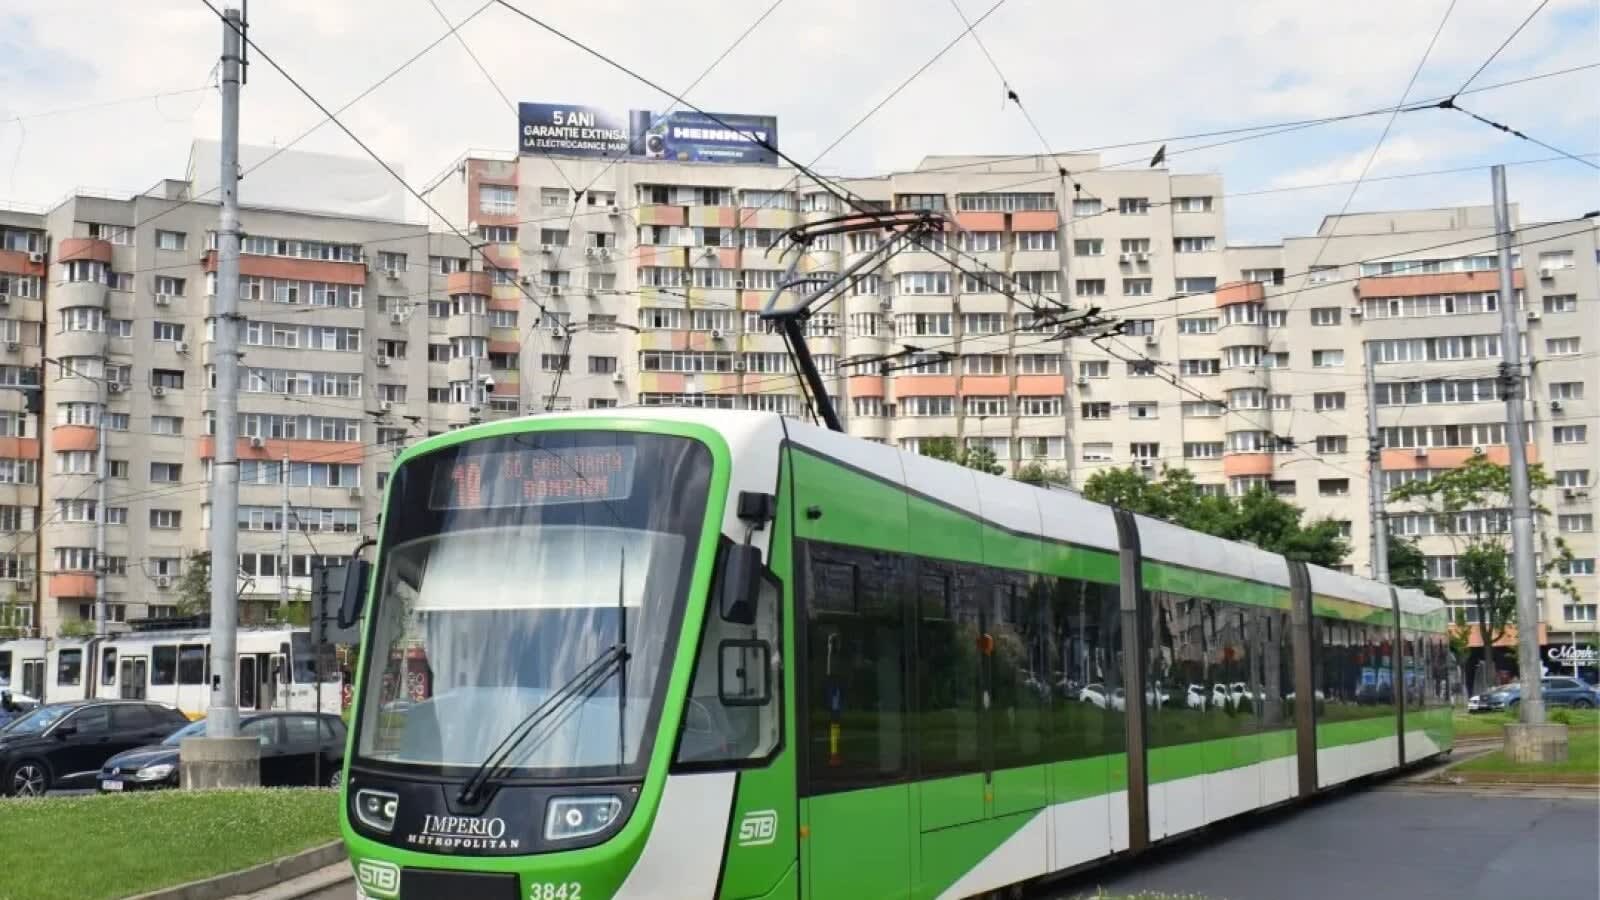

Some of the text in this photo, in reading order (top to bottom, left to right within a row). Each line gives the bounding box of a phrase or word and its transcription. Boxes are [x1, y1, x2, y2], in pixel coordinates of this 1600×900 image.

[553, 110, 595, 127] 5 ANI
[524, 138, 536, 147] LA
[536, 139, 606, 150] ELECTROCASNICE
[421, 814, 506, 839] IMPERIO
[737, 815, 775, 841] STB
[408, 834, 520, 849] METROPOLITAN
[358, 860, 397, 889] STB
[529, 881, 582, 900] 3842
